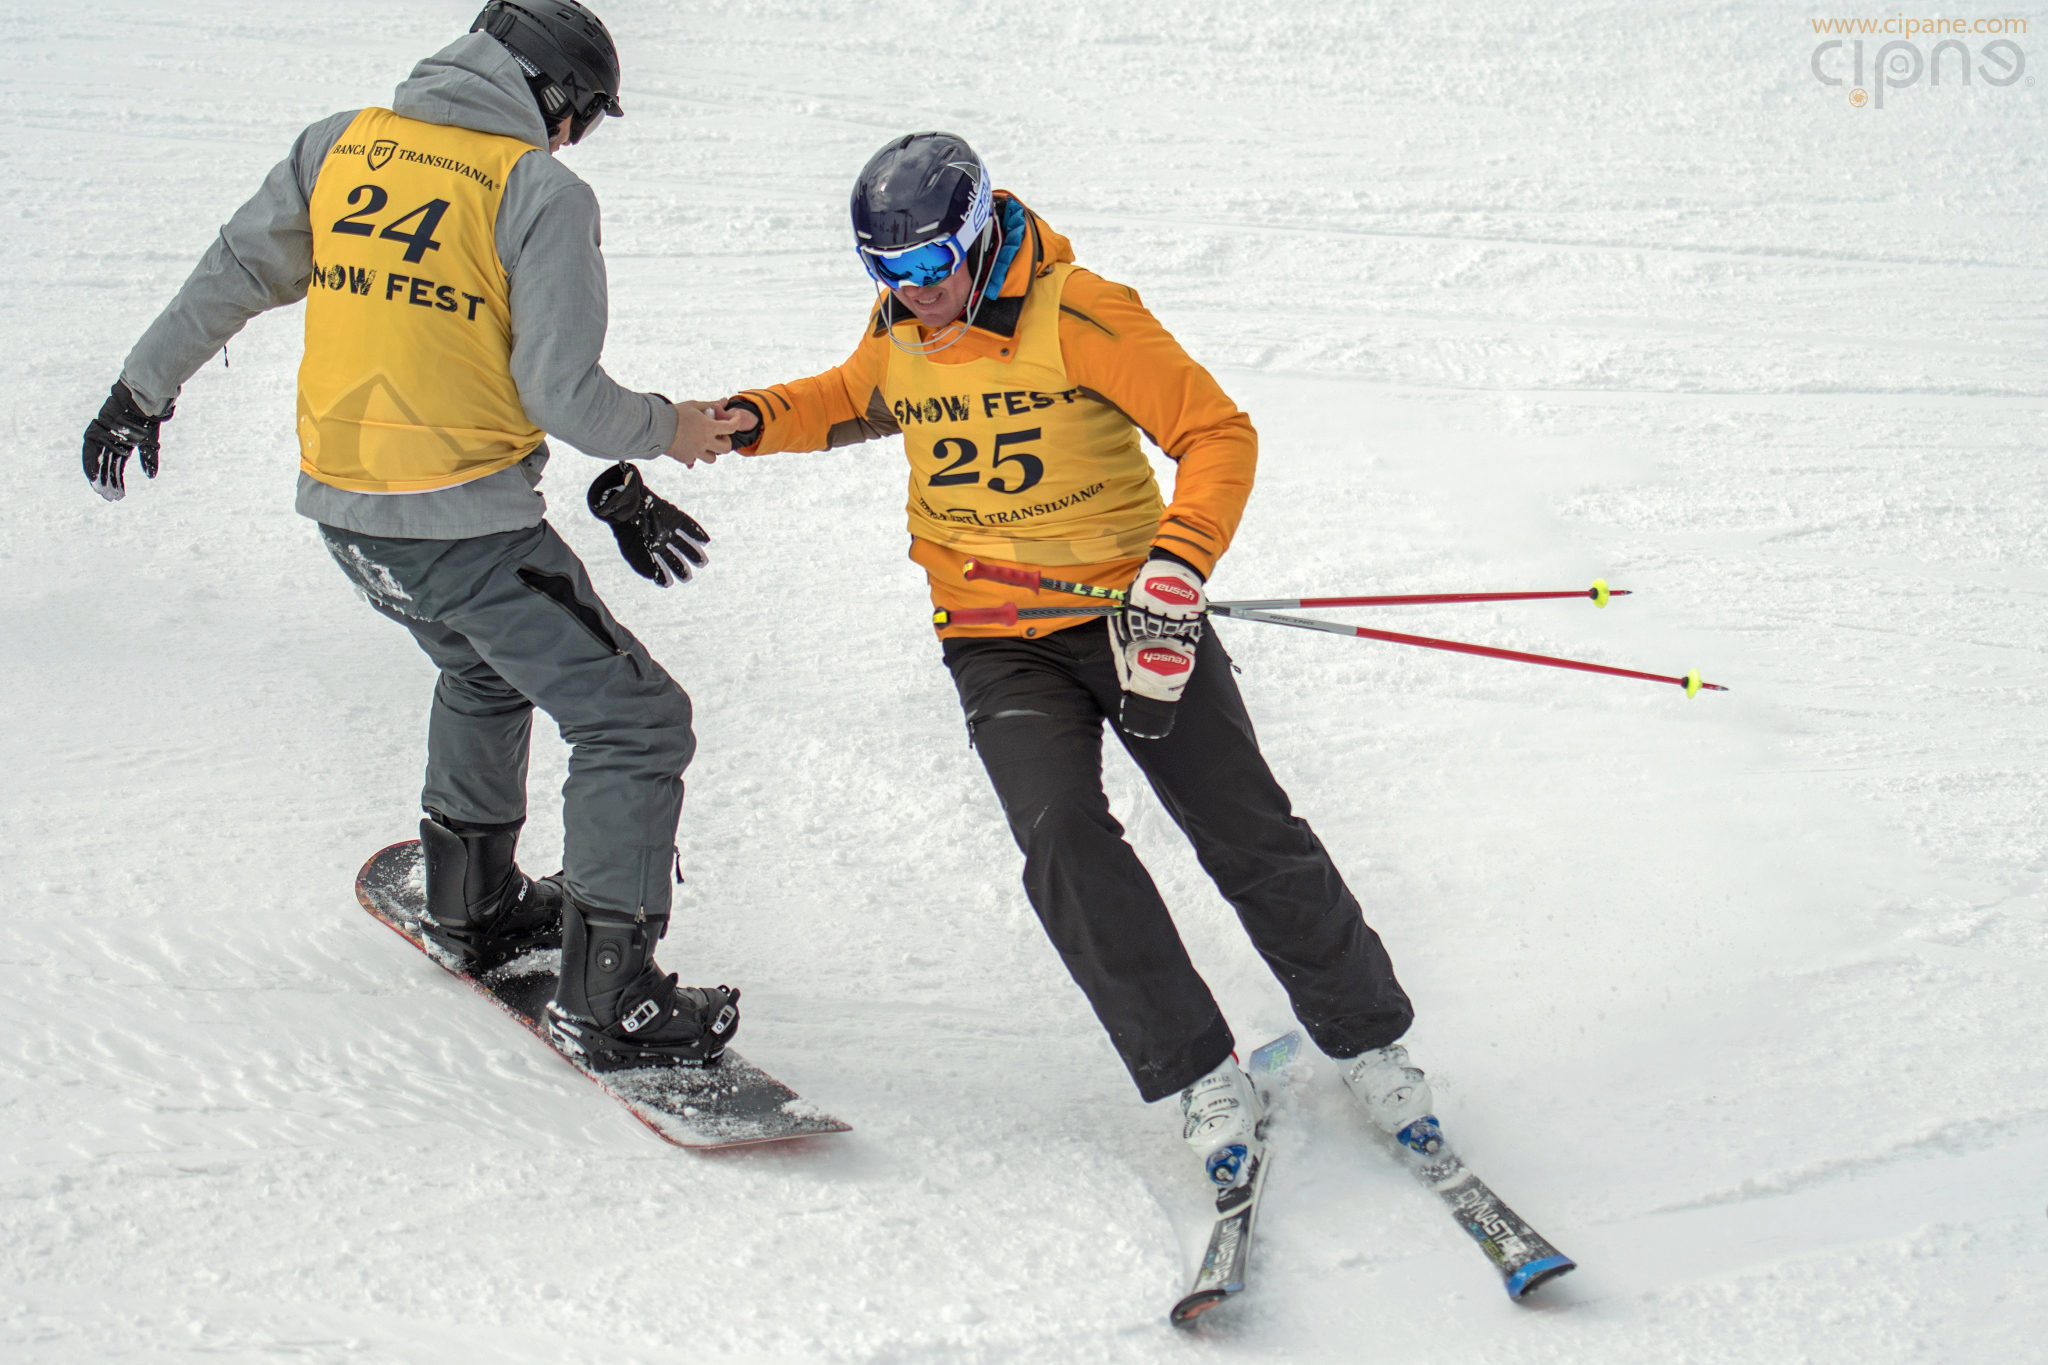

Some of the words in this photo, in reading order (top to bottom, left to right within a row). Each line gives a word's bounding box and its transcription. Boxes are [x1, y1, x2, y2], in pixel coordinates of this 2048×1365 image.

[333, 144, 366, 156] BANCA
[373, 146, 391, 157] BT
[331, 184, 451, 264] 24
[385, 272, 485, 321] FEST
[894, 394, 971, 425] SNOW
[981, 388, 1077, 419] FEST
[928, 427, 1044, 495] 25
[1150, 581, 1196, 601] reusch
[1143, 651, 1187, 664] reusch
